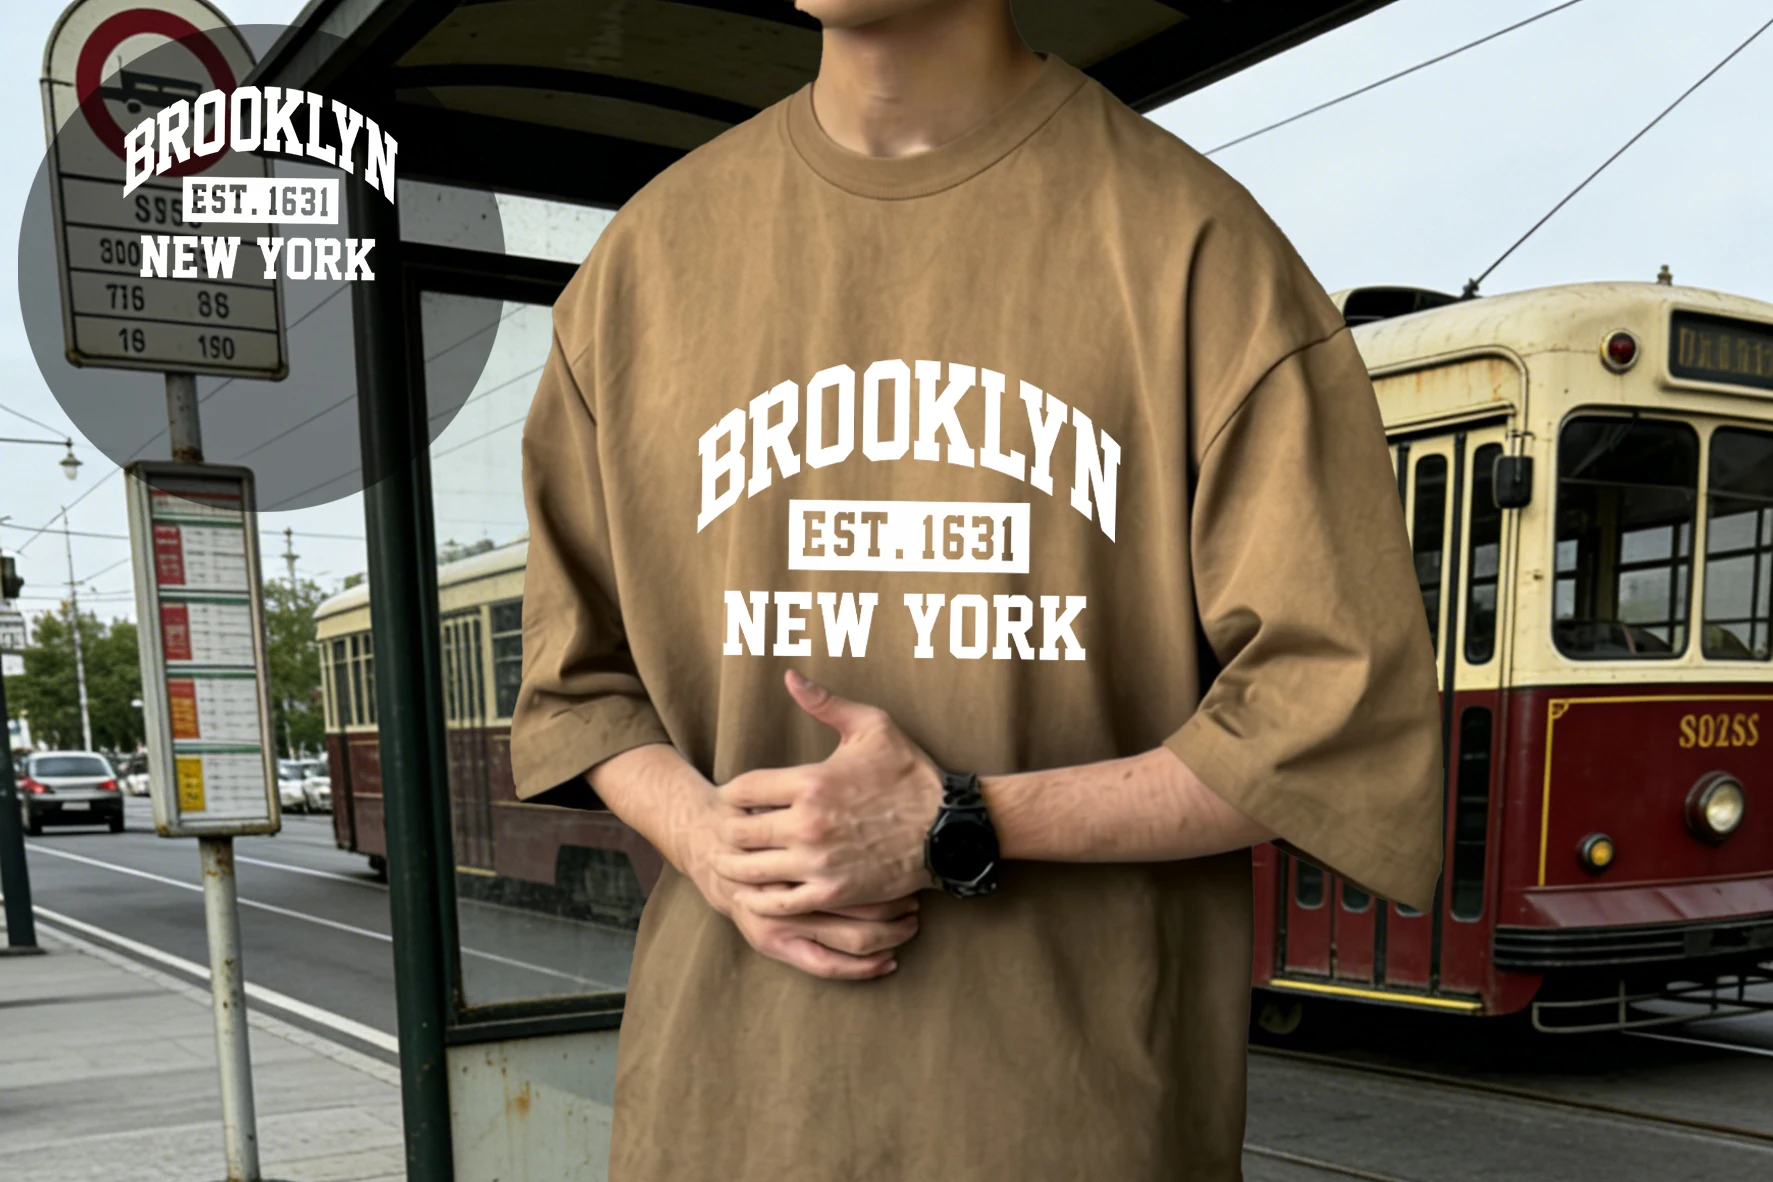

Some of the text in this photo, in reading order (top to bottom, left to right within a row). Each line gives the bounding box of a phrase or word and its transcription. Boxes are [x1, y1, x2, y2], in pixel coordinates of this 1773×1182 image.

[697, 358, 1121, 544] BROOKLYN
[723, 590, 1087, 661] NEW YORK
